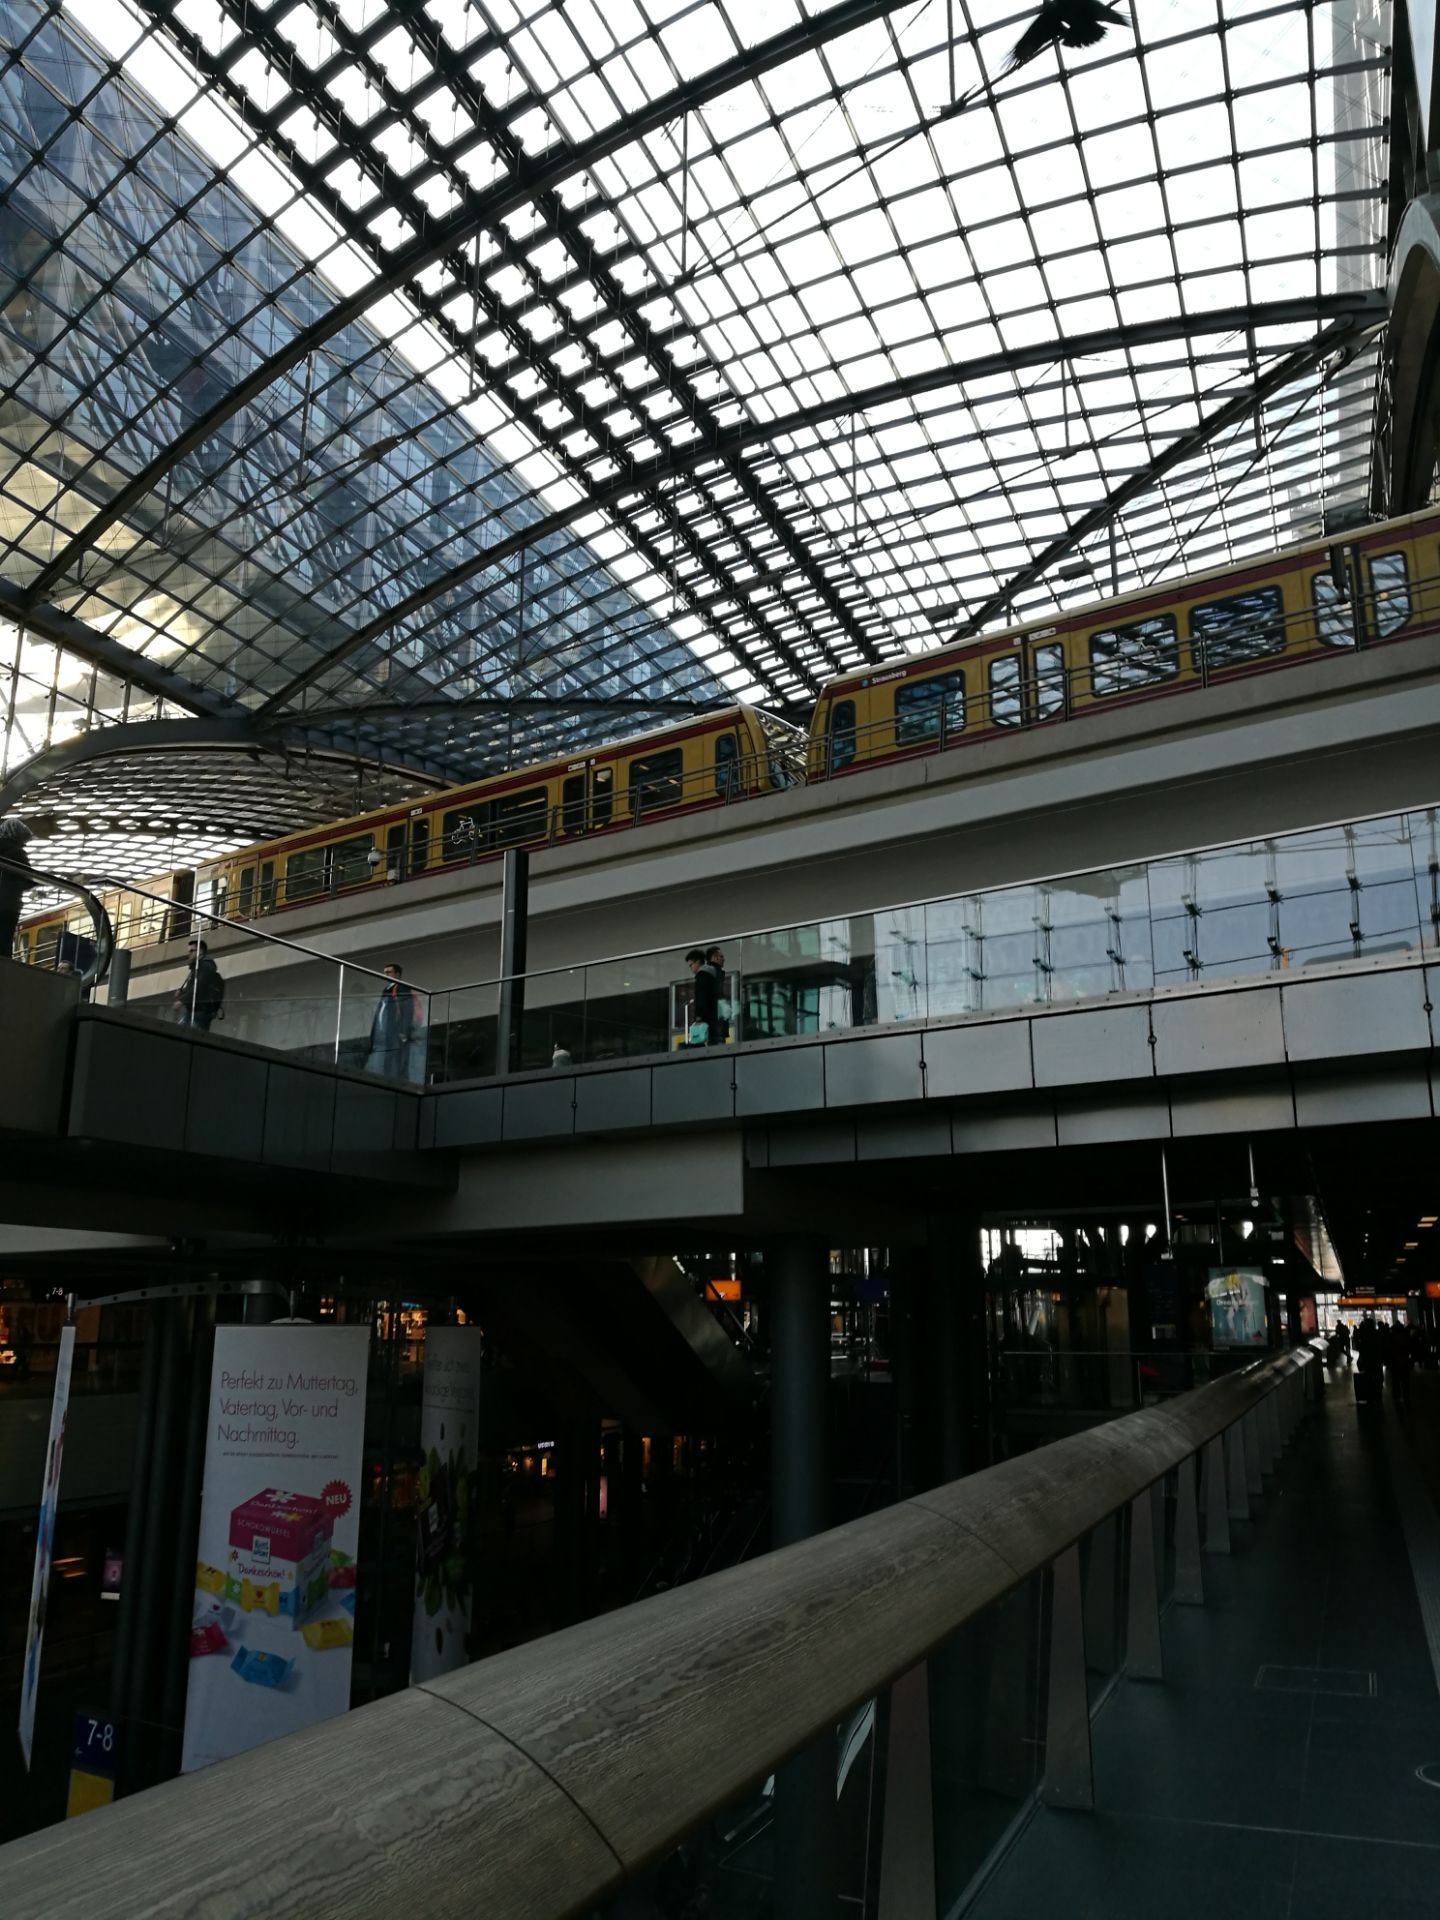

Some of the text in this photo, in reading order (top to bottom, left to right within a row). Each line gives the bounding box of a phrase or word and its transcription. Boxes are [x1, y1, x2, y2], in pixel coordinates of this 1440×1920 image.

[51, 1285, 64, 1296] 7-8
[220, 1370, 359, 1396] Perfekt zu Muttertag,
[219, 1396, 338, 1422] Vatertag, Vor- und
[217, 1423, 300, 1449] Nachmittag.
[325, 1493, 347, 1506] NEU
[87, 1718, 115, 1752] 7-8
